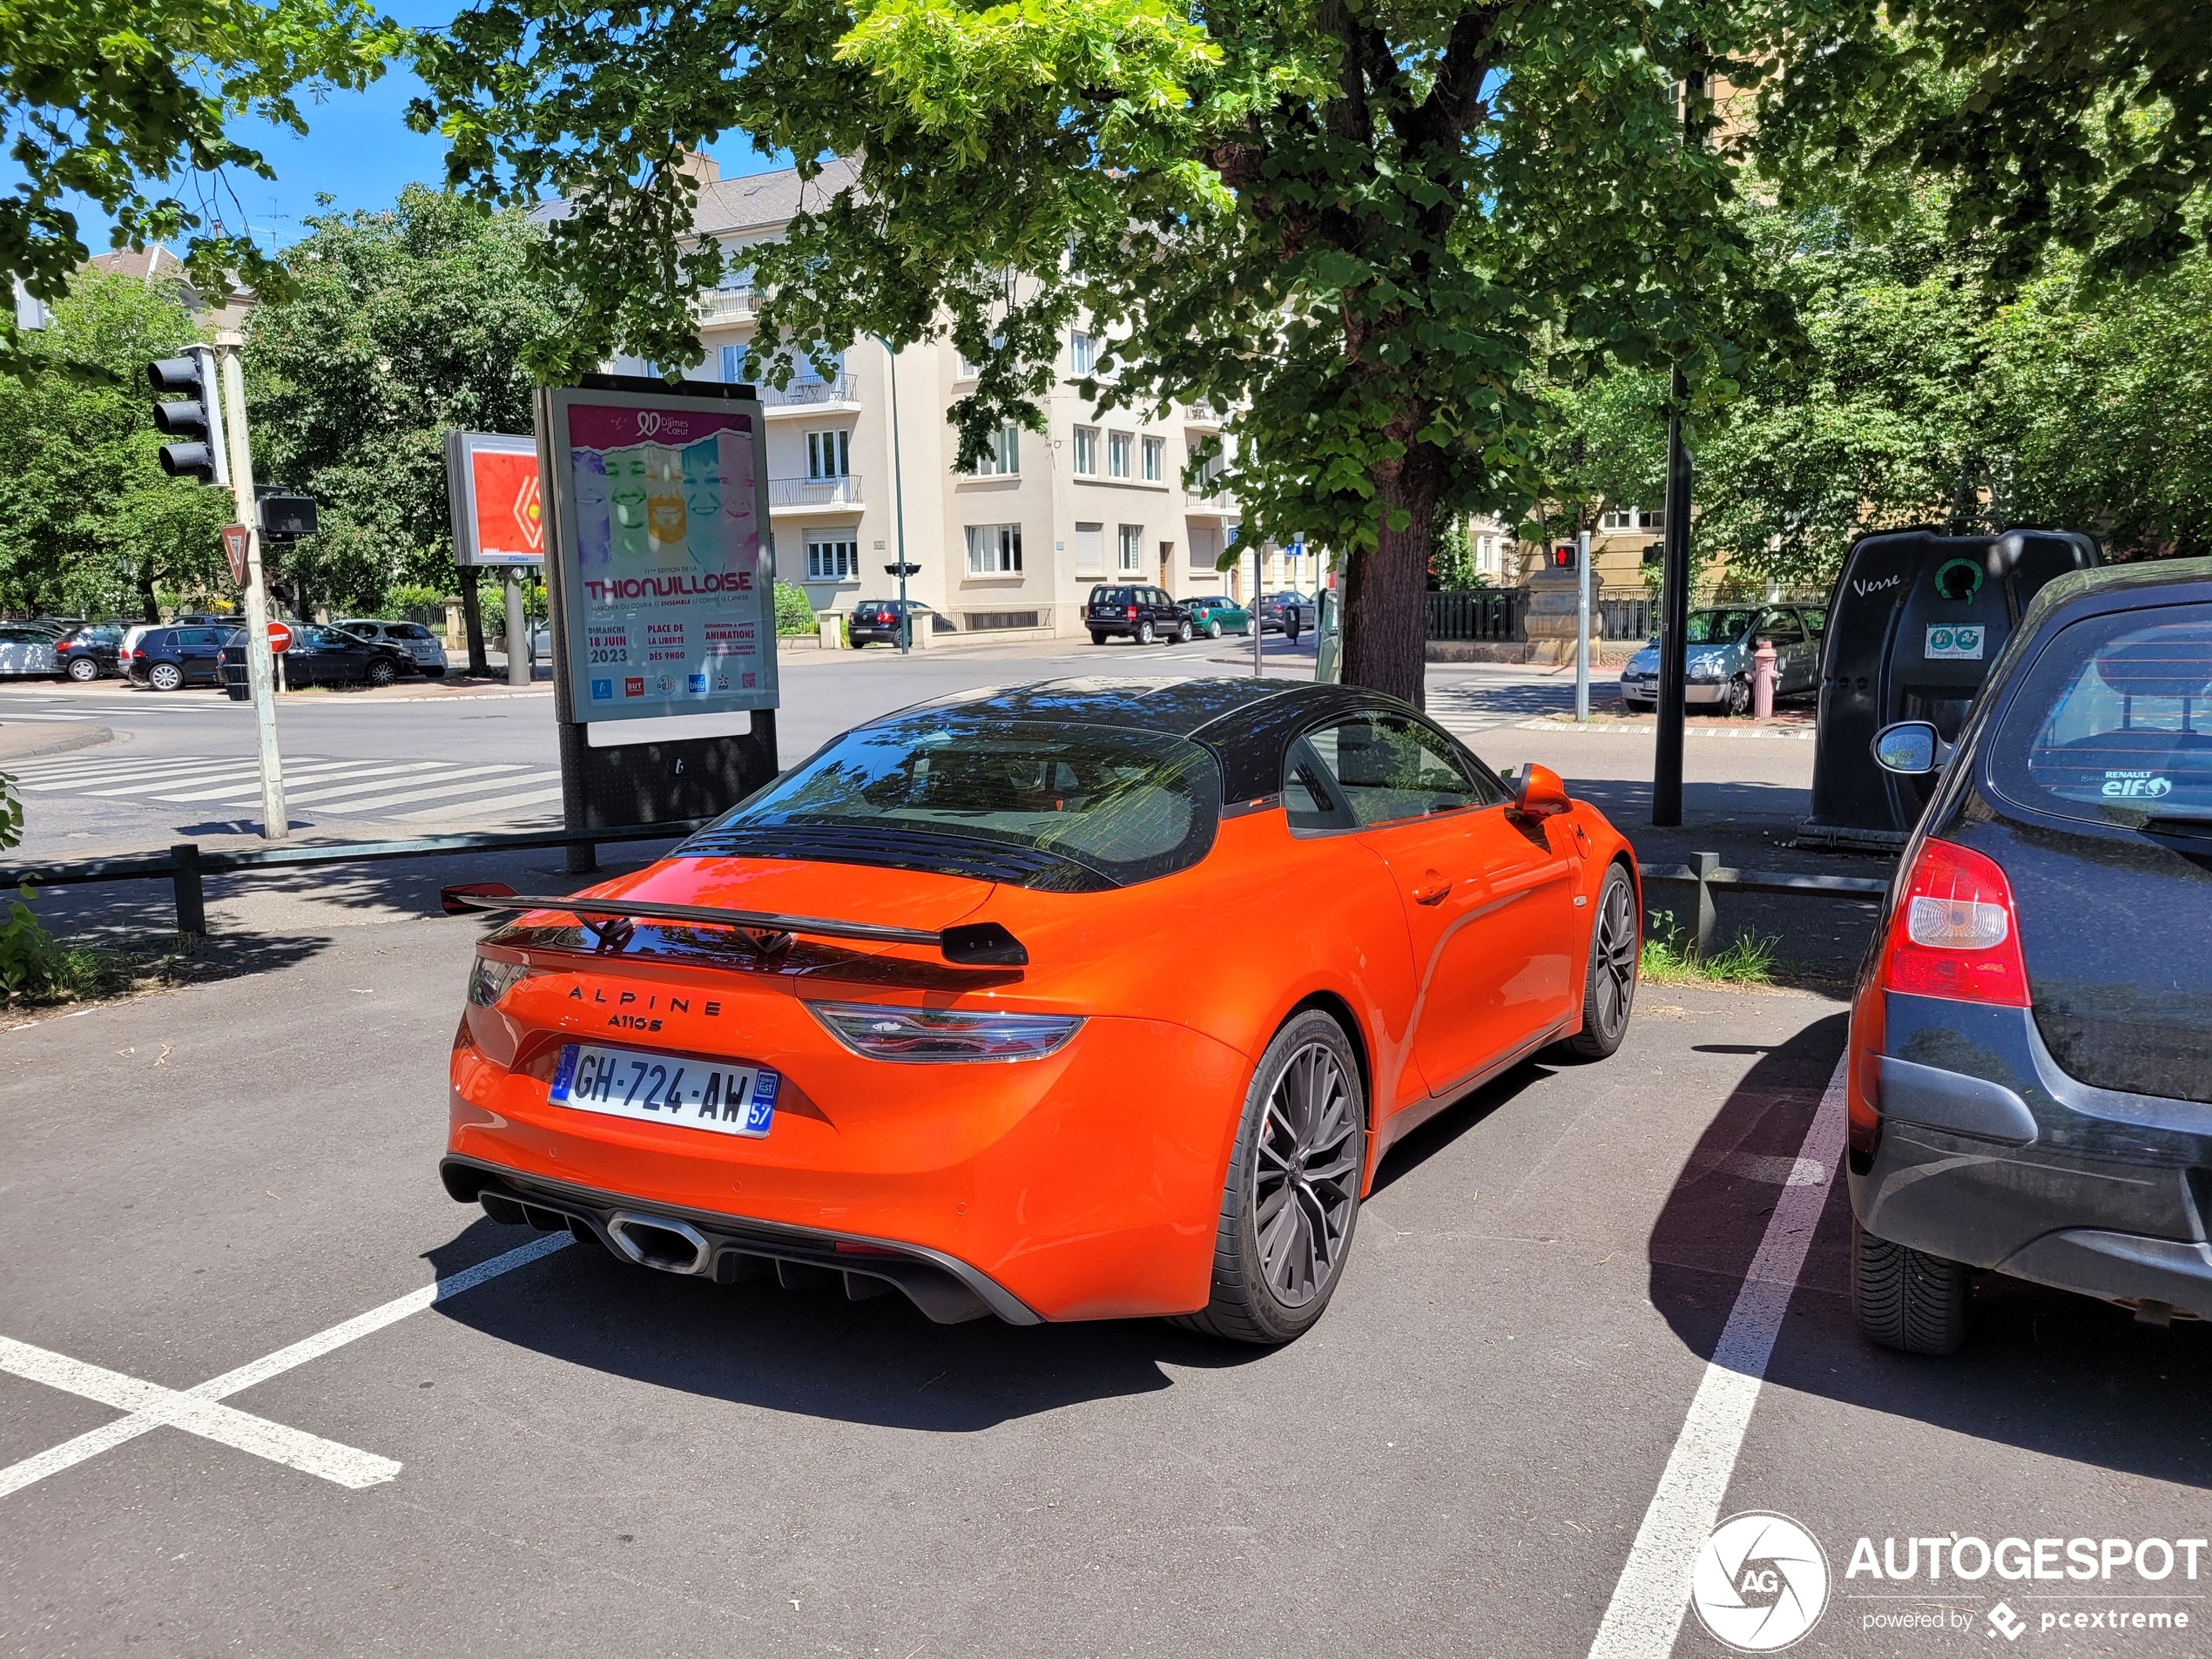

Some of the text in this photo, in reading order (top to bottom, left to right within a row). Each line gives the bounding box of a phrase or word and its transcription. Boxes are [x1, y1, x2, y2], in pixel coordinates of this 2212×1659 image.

[662, 418, 688, 427] Dames
[666, 427, 689, 435] Cœur
[1853, 575, 1901, 597] Verre
[588, 625, 626, 634] DIMANCHE
[647, 624, 684, 633] PLACE DE
[658, 634, 685, 644] LIBERTÉ
[705, 630, 755, 640] ANIMATIONS
[589, 636, 627, 647] 18 JUIN
[590, 648, 628, 663] 2023
[649, 650, 663, 660] DÈS
[2101, 779, 2147, 796] elf
[569, 985, 722, 1017] ALPINE
[607, 1014, 663, 1032] A110S
[574, 1055, 748, 1123] GH-724-AW
[759, 1082, 773, 1093] Est
[749, 1103, 772, 1126] 57
